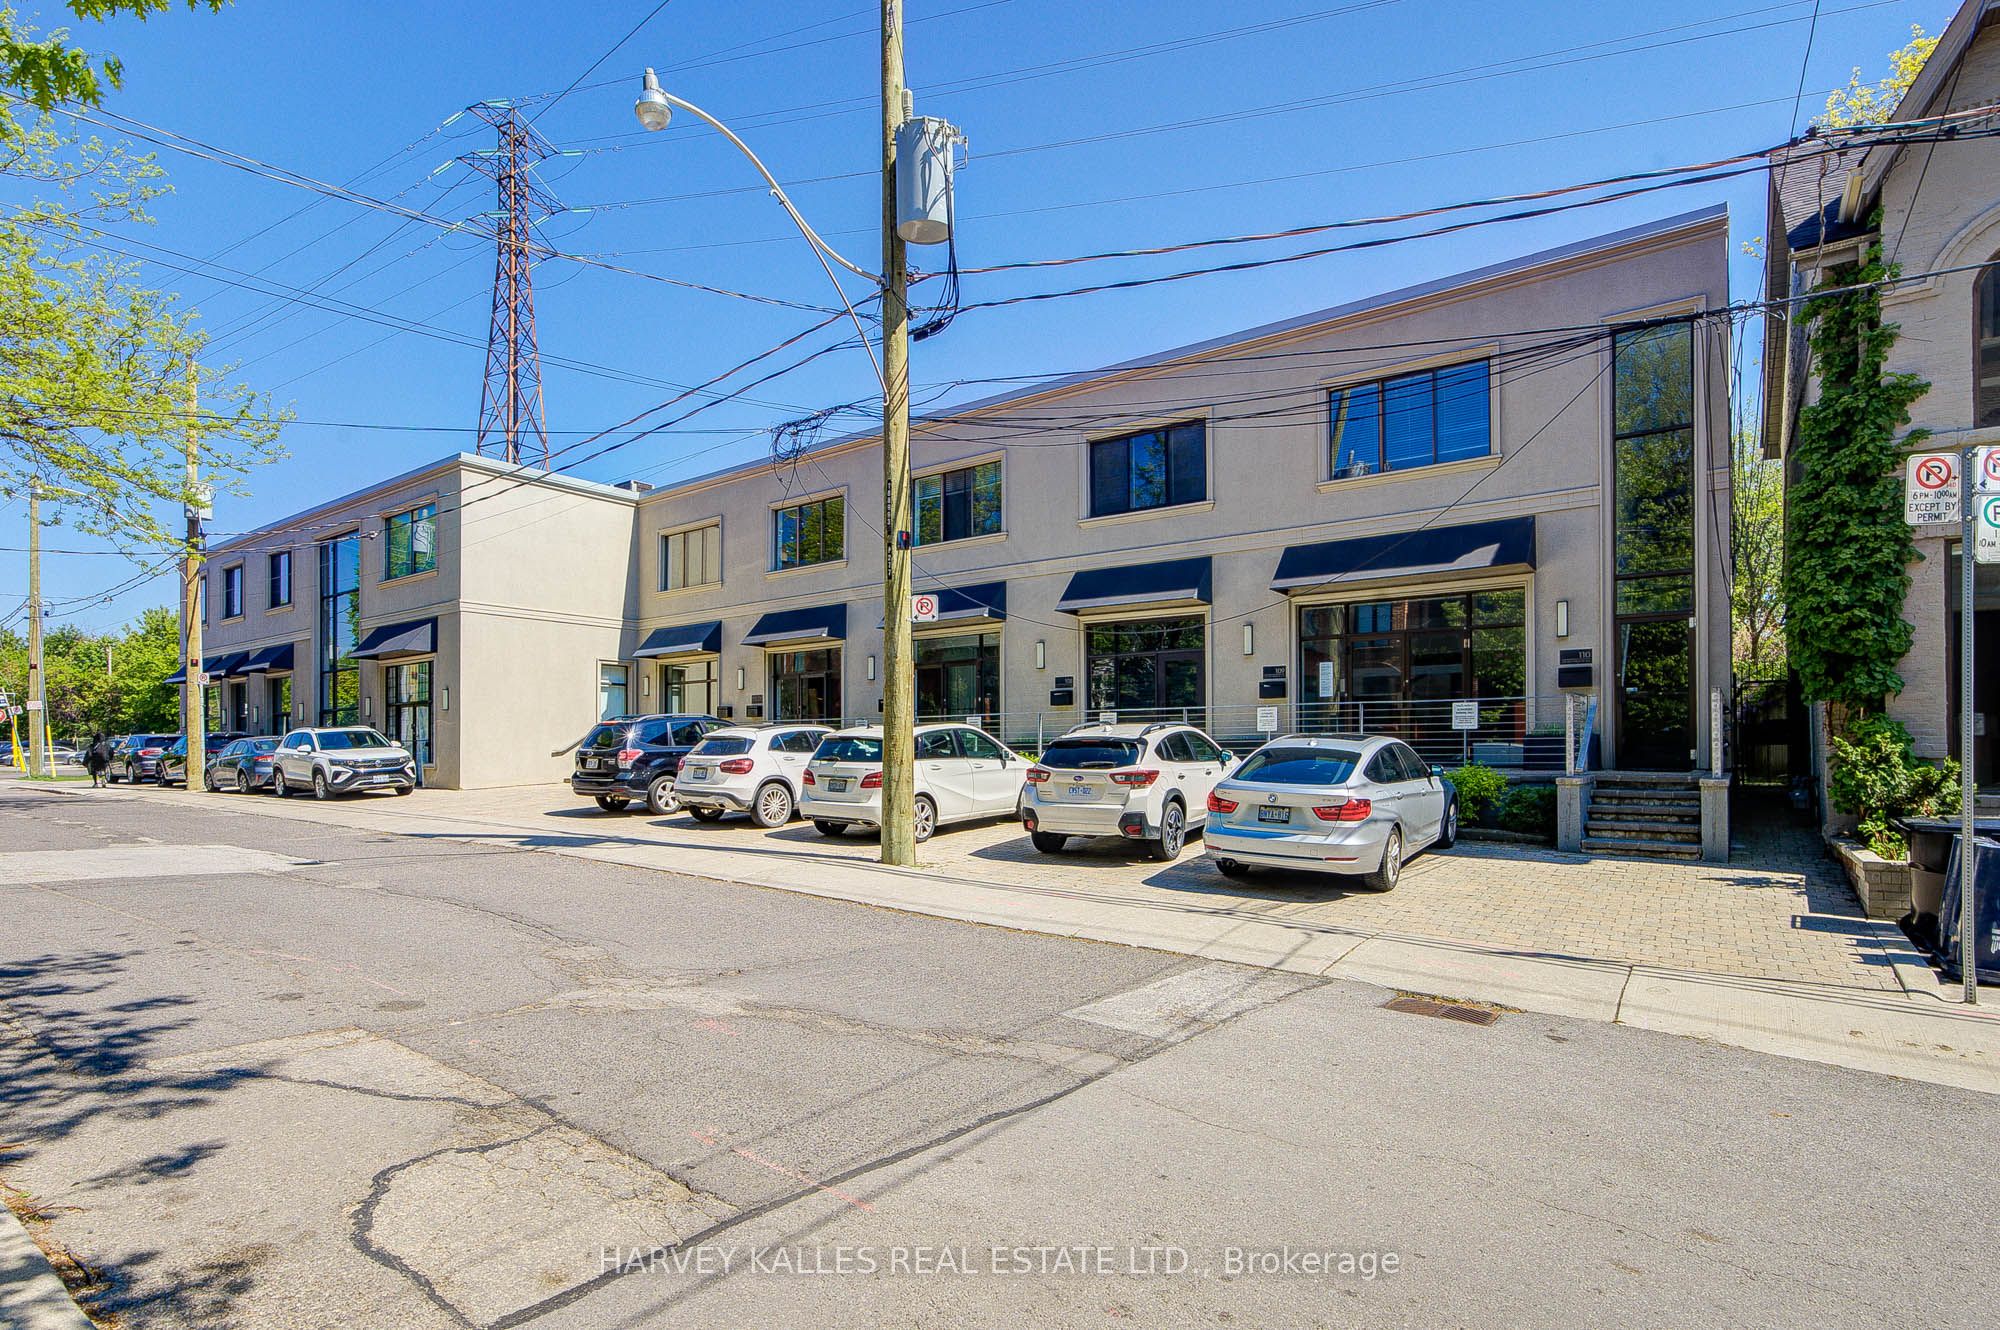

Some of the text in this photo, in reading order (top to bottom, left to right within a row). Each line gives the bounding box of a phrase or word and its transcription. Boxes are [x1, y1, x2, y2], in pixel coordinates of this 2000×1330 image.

[1908, 502, 1957, 512] EXCEPT BY
[1917, 512, 1947, 521] PERMIT
